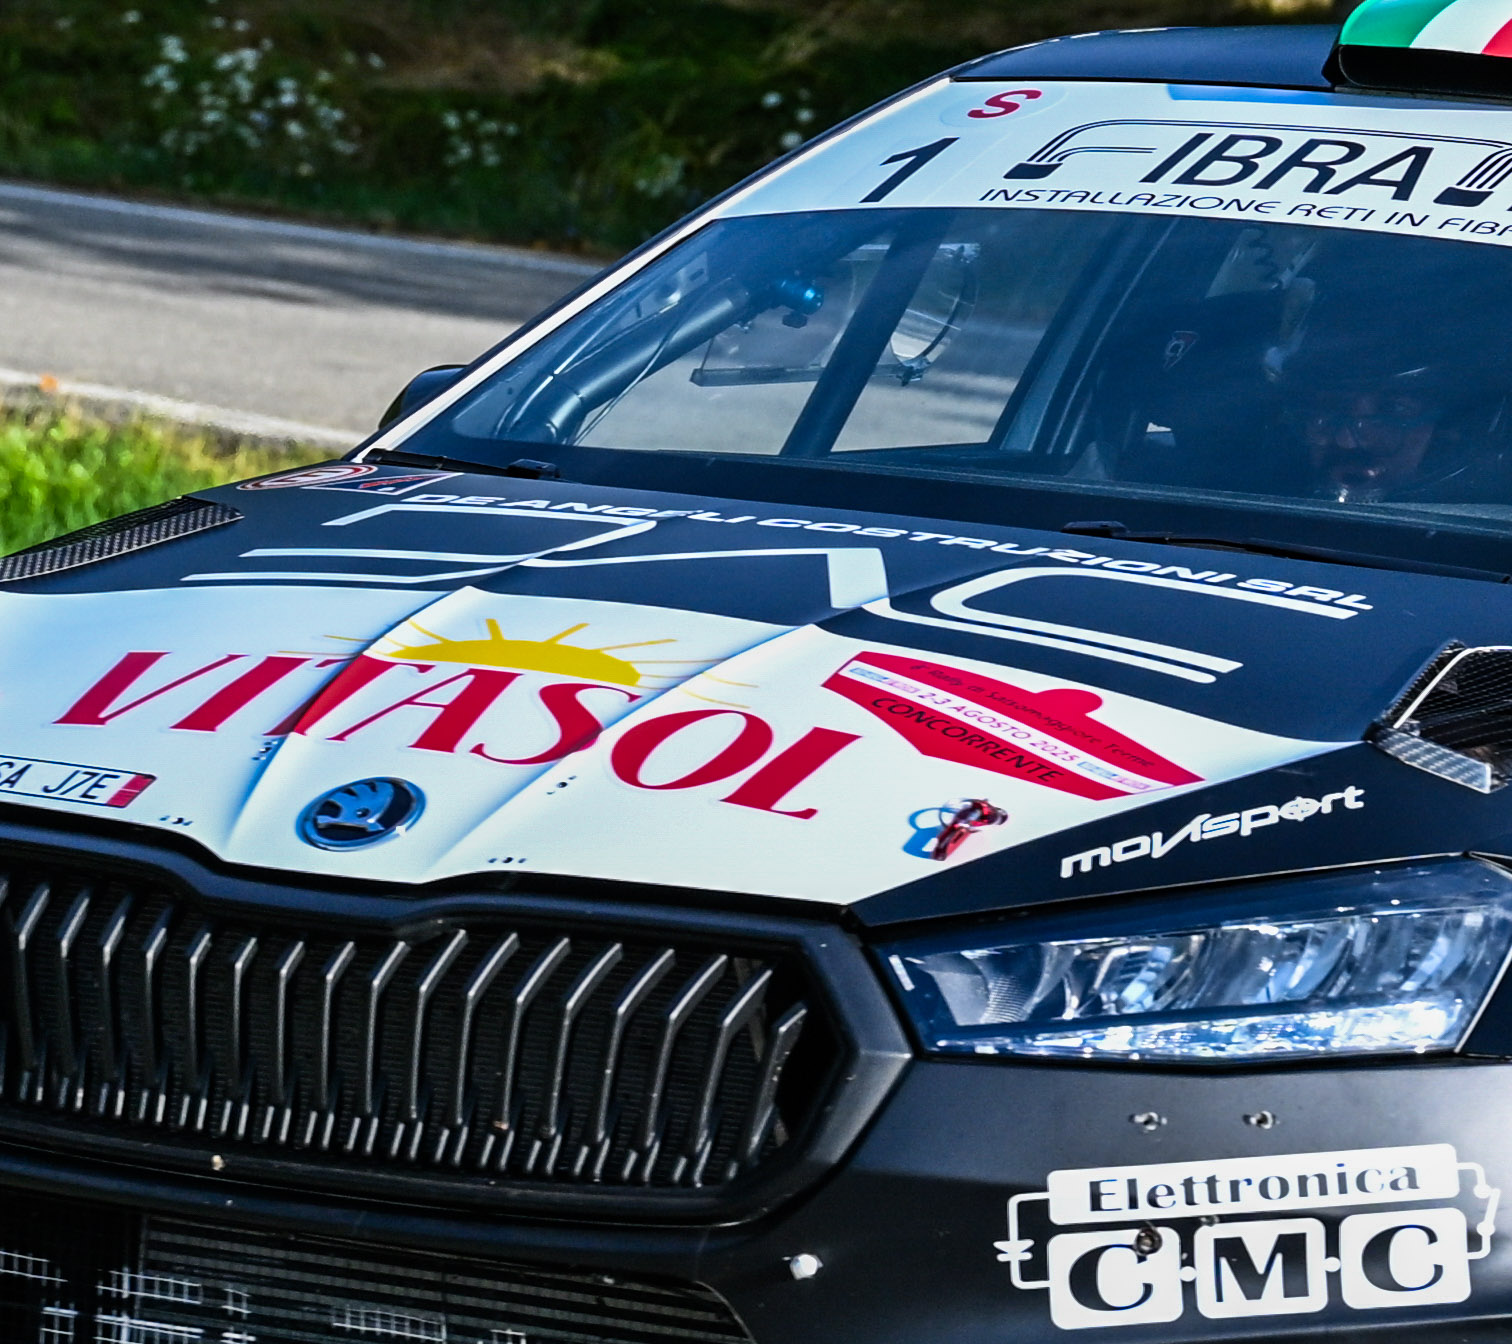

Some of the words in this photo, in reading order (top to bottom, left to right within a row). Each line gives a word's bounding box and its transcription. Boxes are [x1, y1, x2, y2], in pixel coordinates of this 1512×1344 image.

[967, 89, 1042, 119] S
[859, 137, 960, 203] 1
[979, 188, 1281, 214] INSTALLAZIONE
[1287, 202, 1373, 222] RETI
[1384, 208, 1429, 227] IN
[401, 494, 506, 505] DE
[500, 499, 757, 524] ANGELI
[758, 518, 1238, 584] COSTRUZIONI
[1235, 578, 1374, 611] SRL
[53, 651, 863, 820] VITASOL
[871, 697, 1064, 784] CONCORRENTE
[918, 689, 951, 705] 2-3
[948, 700, 1032, 740] AGOSTO
[1030, 740, 1081, 762] 2025
[1089, 1163, 1420, 1212] Elettronica
